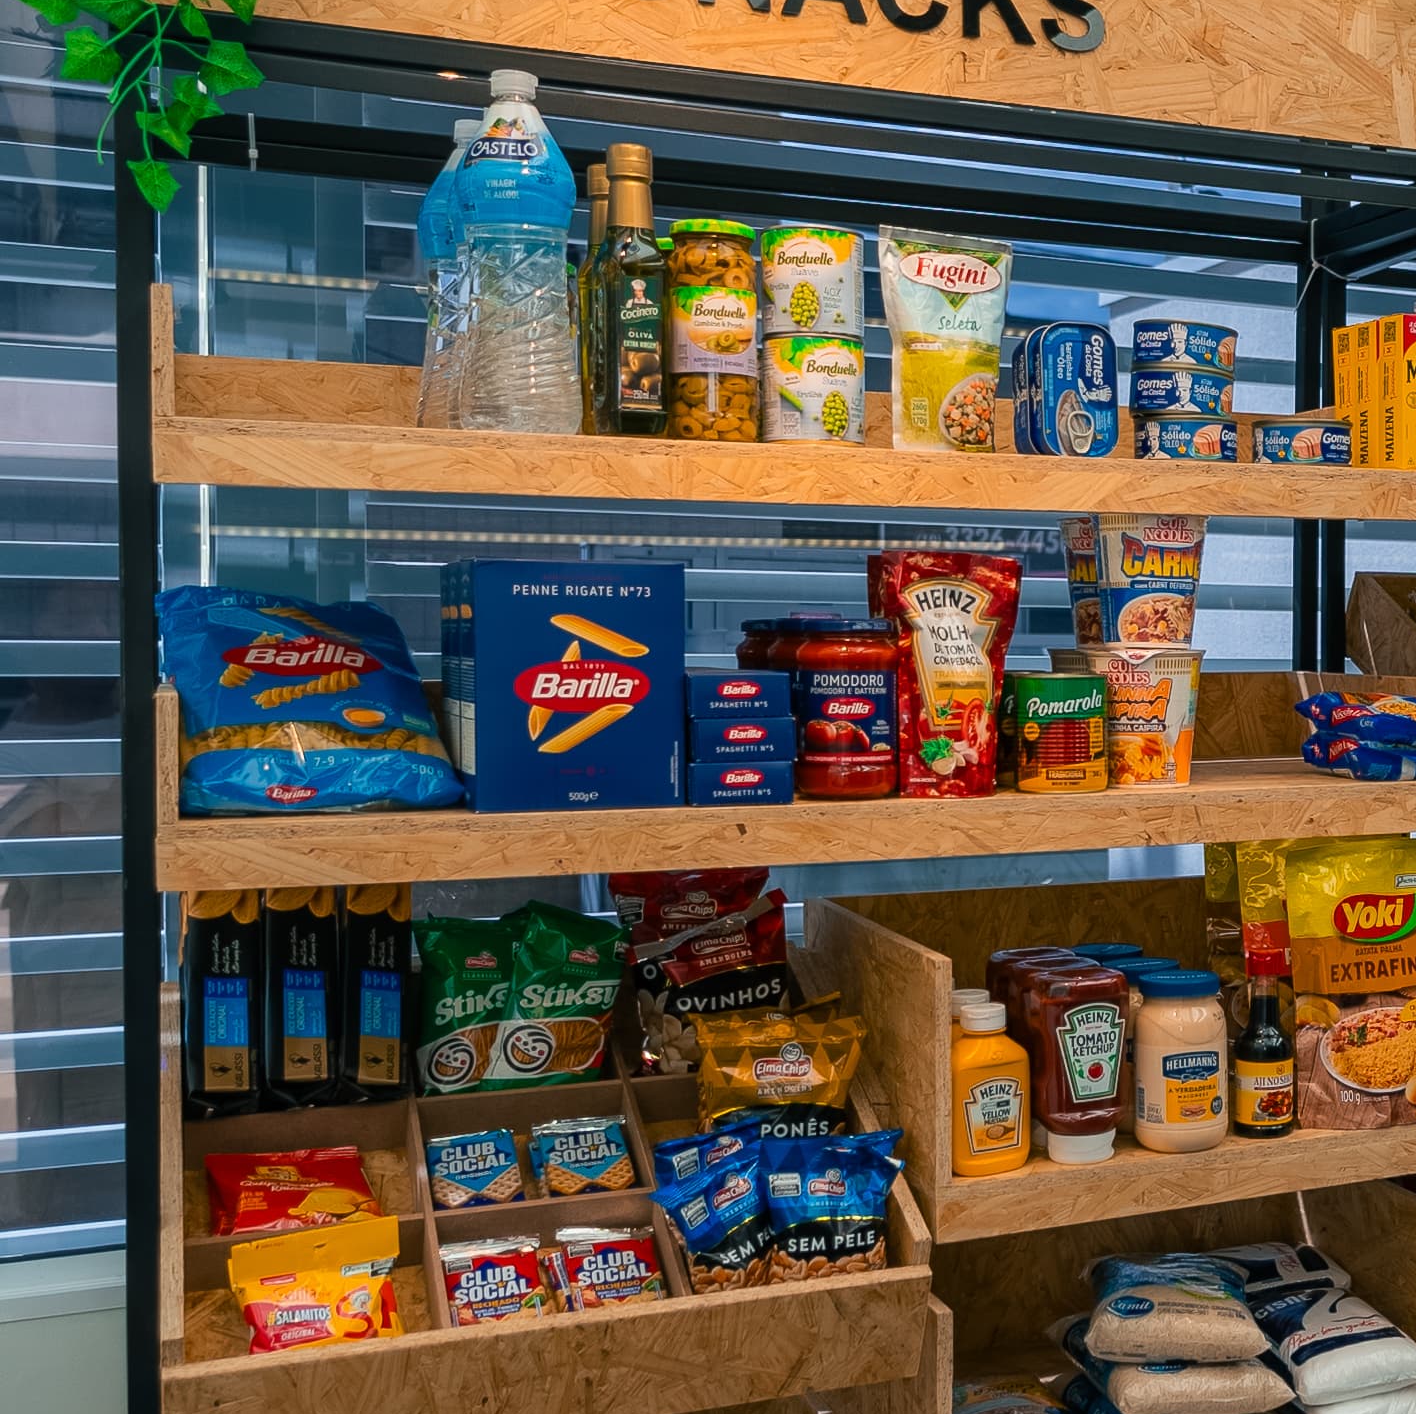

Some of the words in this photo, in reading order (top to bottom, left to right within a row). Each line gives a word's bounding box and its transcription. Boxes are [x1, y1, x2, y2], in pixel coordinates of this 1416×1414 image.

[470, 140, 539, 159] CASTELO
[777, 252, 833, 267] Bonduelle
[916, 257, 988, 287] Fugini
[621, 306, 658, 320] Cocinero
[694, 303, 746, 322] Bonduelle
[938, 314, 981, 331] Seleta
[628, 331, 653, 339] OLIVA
[1137, 332, 1168, 343] Gomes
[1189, 336, 1217, 348] Sólido
[1091, 335, 1103, 385] Gomes
[806, 360, 857, 377] Bonduelle
[1137, 380, 1173, 392] Gomes
[1194, 385, 1220, 397] Sólido
[1162, 430, 1191, 441] Sólido
[1265, 435, 1290, 447] Sólido
[1360, 410, 1368, 465] MAIZENA
[1385, 406, 1394, 462] MAIZENA
[1156, 517, 1189, 529] CUP
[1143, 527, 1194, 543] NOODLES
[513, 585, 559, 596] PENNE
[566, 585, 613, 597] RIGATE
[915, 587, 977, 615] HEINZ
[244, 643, 365, 667] Barilla
[1107, 658, 1138, 673] CUP
[531, 672, 634, 699] Barilla
[813, 674, 884, 687] POMODORO
[722, 684, 758, 695] Barilla
[709, 700, 752, 709] SPAGHETTI
[828, 702, 871, 715] Barilla
[1027, 689, 1102, 718] Pomarola
[728, 729, 764, 740] Barilla
[1133, 723, 1163, 732] CAIPIRA
[715, 744, 758, 753] SPAGHETTI
[725, 773, 761, 784] Barilla
[569, 792, 589, 802] 500g
[712, 788, 755, 797] SPAGHETTI
[1342, 898, 1404, 933] Yoki
[693, 934, 745, 950] ElmaChips
[1380, 945, 1403, 953] PALHA
[520, 980, 622, 1009] Stiksy
[676, 978, 782, 1012] OVINHOS
[1076, 1012, 1111, 1027] HEINZ
[1068, 1030, 1117, 1048] TOMATO
[1072, 1042, 1115, 1057] KETCHUP
[755, 1061, 811, 1075] ElmaChips
[1166, 1053, 1218, 1071] HELLMANN'S
[980, 1083, 1013, 1100] HEINZ
[1340, 1091, 1353, 1103] 100
[981, 1107, 1012, 1120] YELLOW
[554, 1132, 606, 1151] CLUB
[441, 1141, 495, 1162] CLUB
[548, 1144, 623, 1165] SOCIAL
[435, 1154, 511, 1176] SOCIAL
[788, 1236, 826, 1253] SEM
[834, 1230, 875, 1249] PELE
[721, 1240, 756, 1264] SEM
[582, 1250, 636, 1271] CLUB
[460, 1265, 517, 1287] CLUB
[578, 1263, 652, 1287] SOCIAL
[454, 1279, 533, 1306] SOCIAL
[1108, 1298, 1154, 1315] Camil
